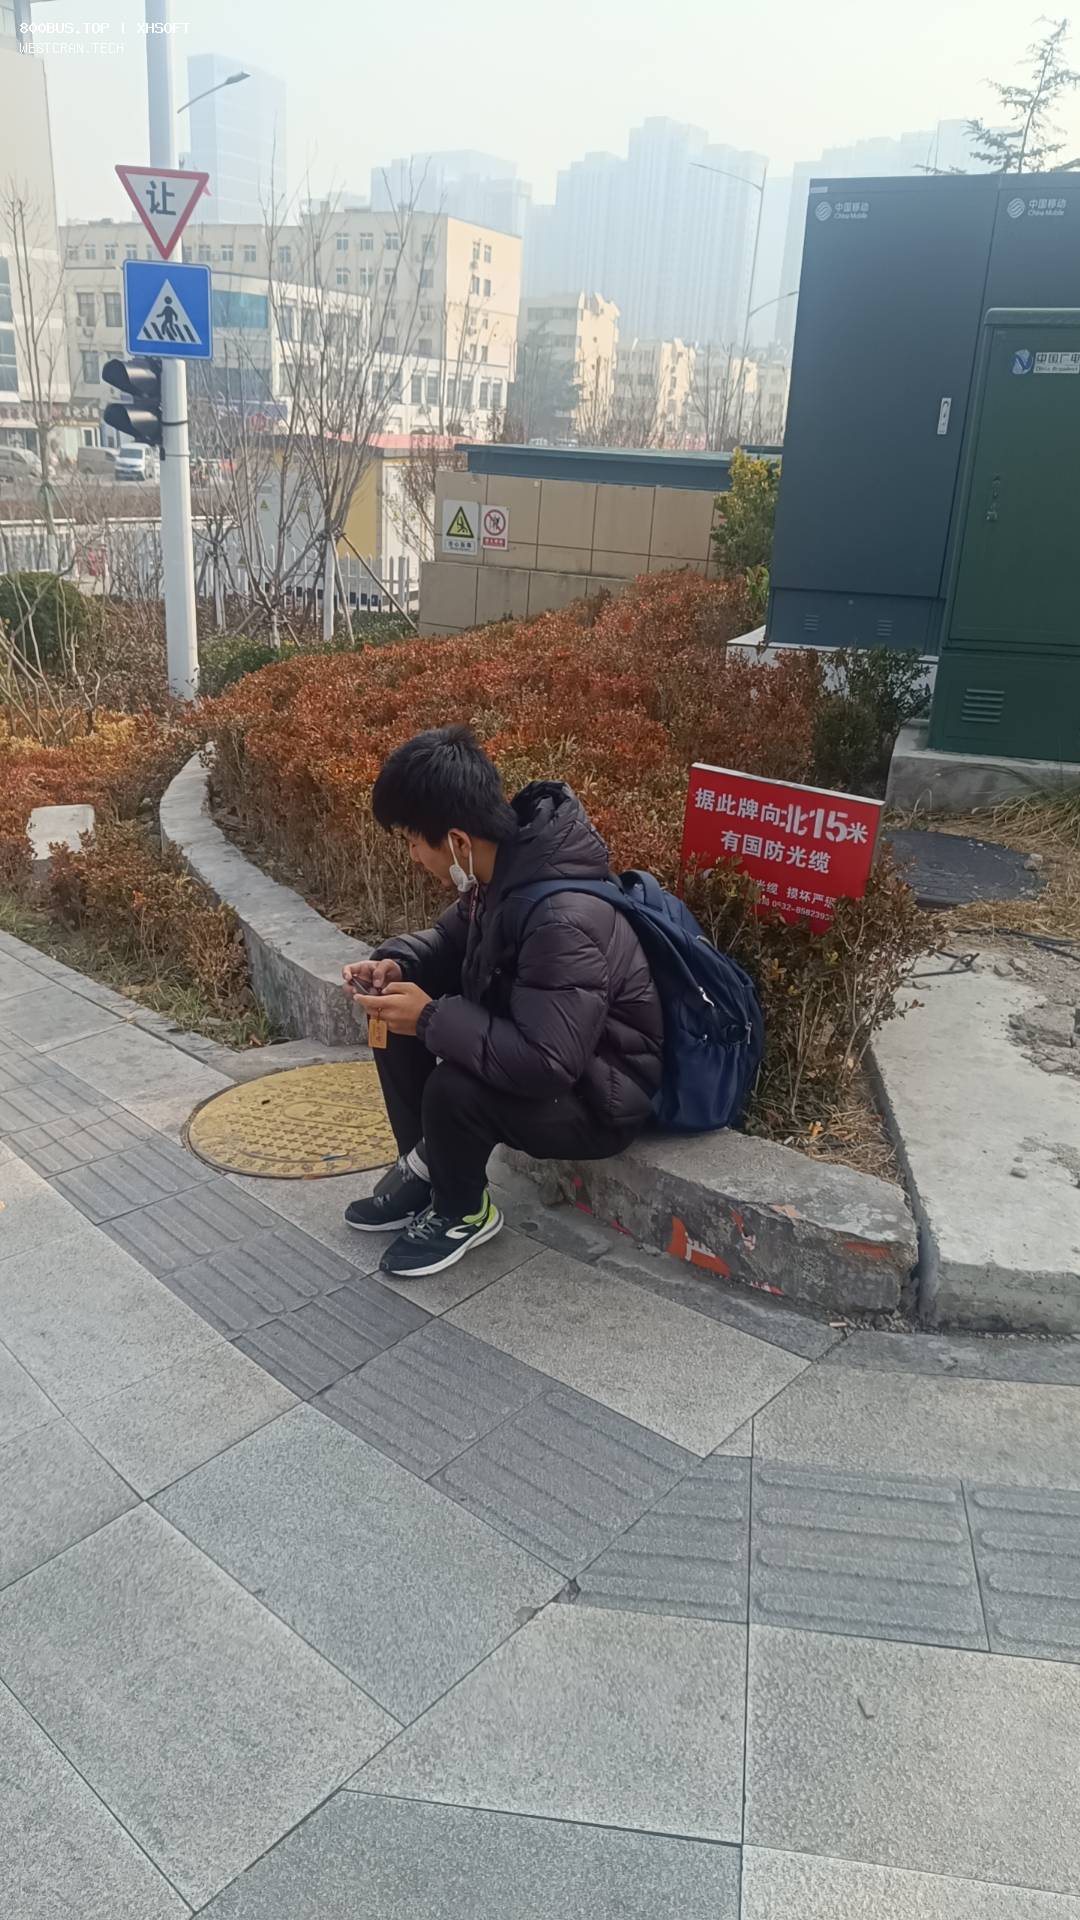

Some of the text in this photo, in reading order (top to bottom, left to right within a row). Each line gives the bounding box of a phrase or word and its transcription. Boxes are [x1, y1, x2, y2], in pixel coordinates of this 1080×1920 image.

[146, 180, 176, 216] 让
[720, 830, 832, 875] 有国防光缆
